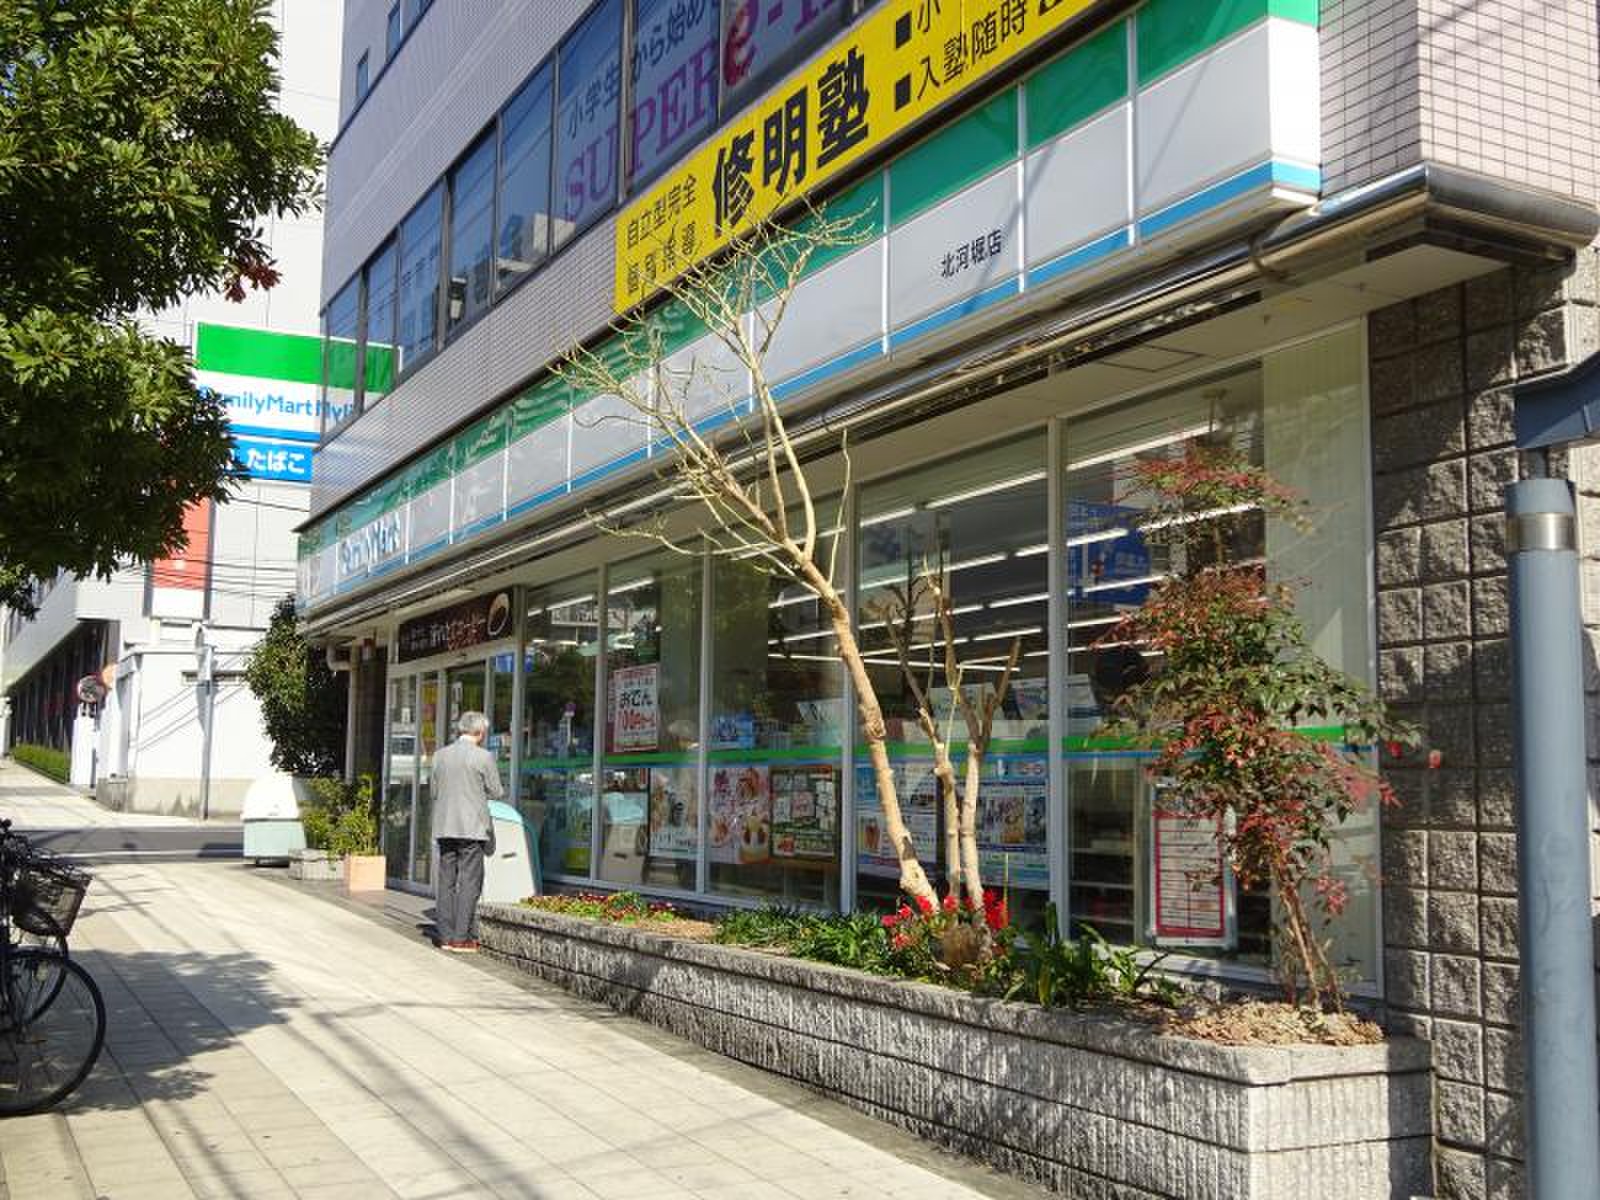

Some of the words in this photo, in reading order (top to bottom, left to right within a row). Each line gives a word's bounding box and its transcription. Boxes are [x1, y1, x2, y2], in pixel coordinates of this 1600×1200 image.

[917, 0, 1026, 101] 入塾随時
[712, 45, 870, 239] 修明塾
[627, 173, 696, 249] 自立型完全
[941, 229, 1002, 278] 北河堀店
[247, 448, 305, 474] たばこ
